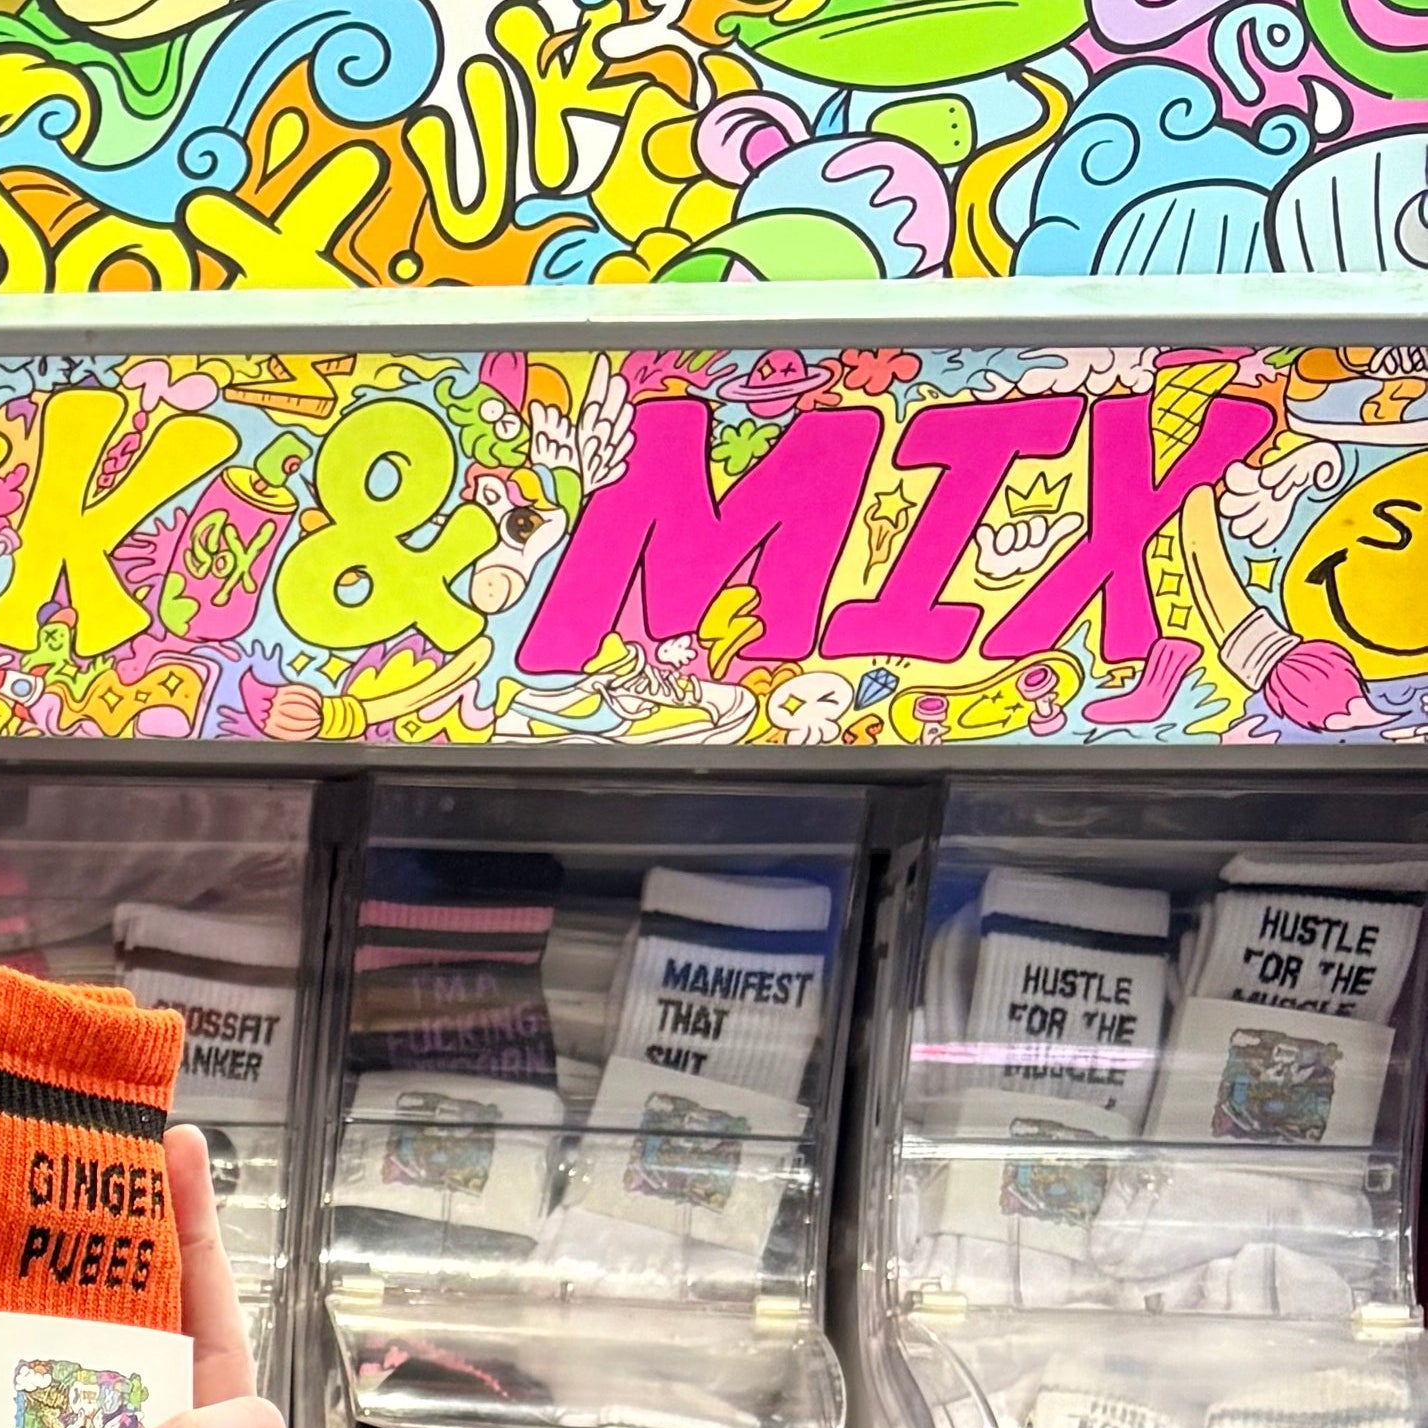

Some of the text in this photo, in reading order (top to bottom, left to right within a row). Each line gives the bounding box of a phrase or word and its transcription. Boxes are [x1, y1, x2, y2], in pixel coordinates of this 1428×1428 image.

[275, 397, 506, 657] &
[516, 392, 1280, 676] MIX
[1258, 905, 1380, 957] HUSTLE
[662, 957, 814, 1007] MANIFEST
[1022, 962, 1133, 1005] HUSTLE
[1243, 947, 1378, 996] FOR THE
[657, 997, 730, 1041] THAT
[1008, 1002, 1137, 1046] FOR THE
[27, 1150, 166, 1221] GINGER
[18, 1224, 156, 1293] PUBES
